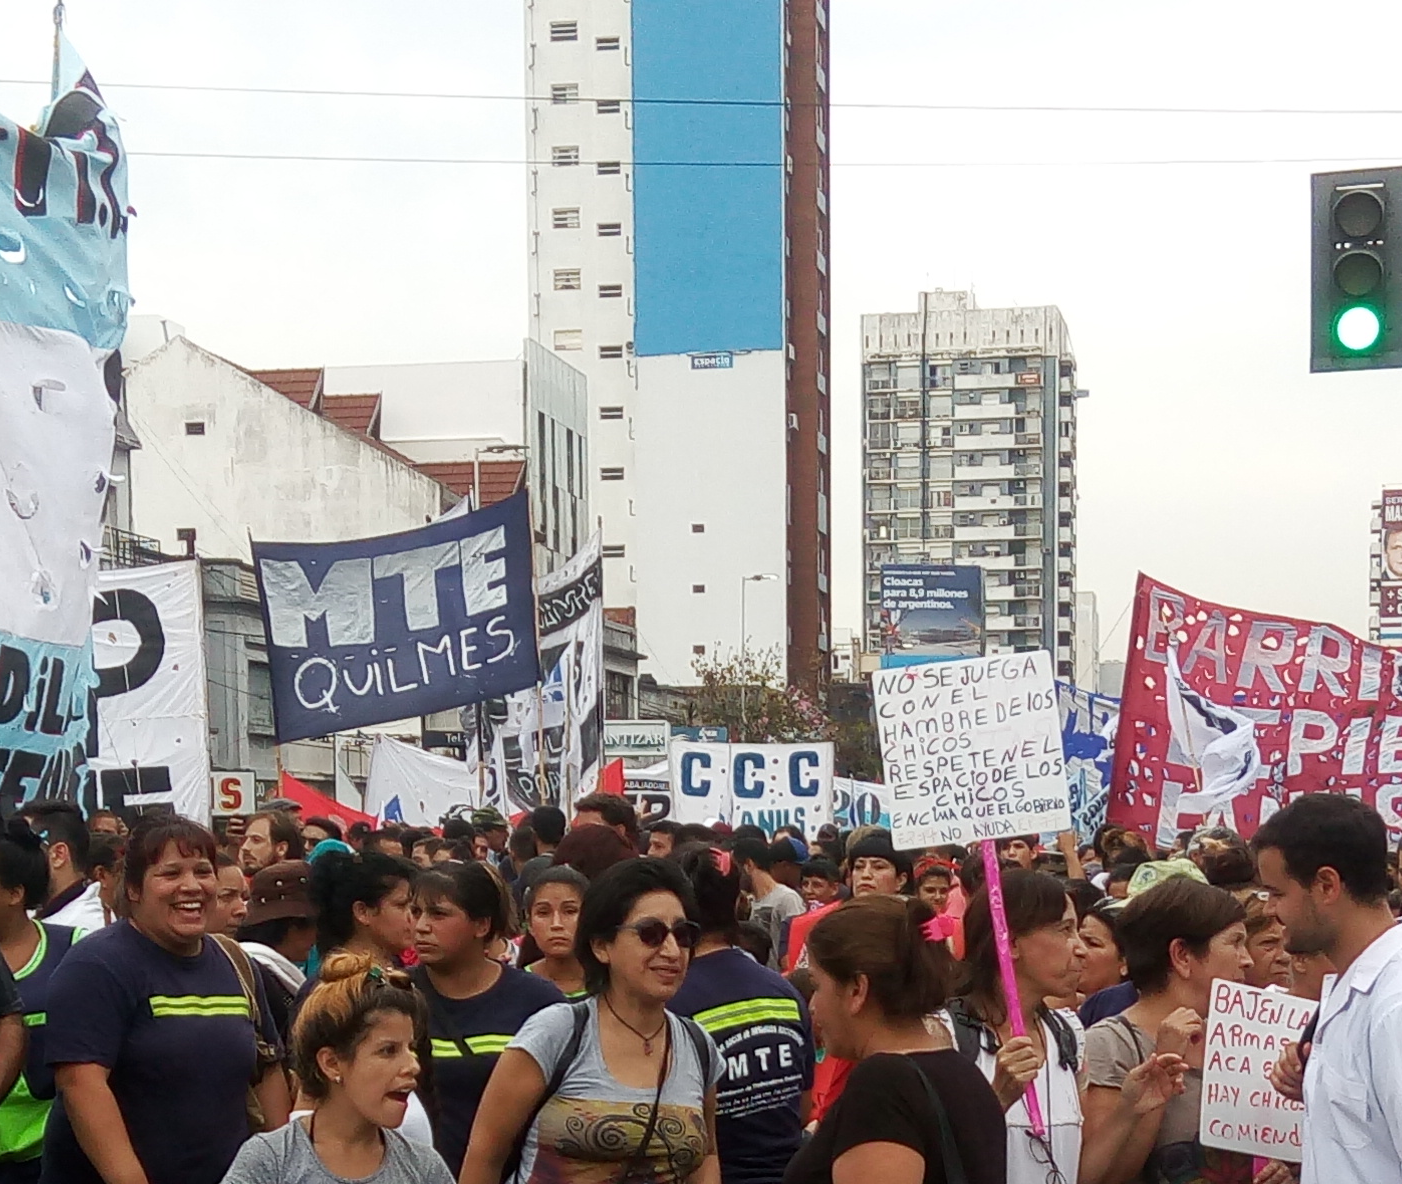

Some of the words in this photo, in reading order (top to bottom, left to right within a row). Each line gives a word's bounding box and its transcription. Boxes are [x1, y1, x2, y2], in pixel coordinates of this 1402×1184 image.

[258, 524, 507, 650] MTE
[883, 577, 924, 586] Cloacas
[883, 589, 907, 598] para
[909, 588, 925, 599] 8,9
[926, 588, 969, 598] millones
[883, 599, 896, 608] de
[898, 599, 955, 609] argentinos.
[877, 674, 915, 696] NO
[923, 666, 954, 690] SE
[960, 656, 1037, 687] JUEGA
[879, 693, 940, 719] CON
[951, 686, 988, 706] EL
[883, 708, 988, 744] HAMBRE
[997, 697, 1022, 723] DE
[889, 744, 1018, 784] RESPETEN
[991, 765, 1017, 783] DE
[1025, 757, 1063, 779] LOS
[960, 802, 995, 819] QUE
[998, 801, 1013, 815] EL
[940, 824, 962, 843] NO
[973, 818, 1016, 839] AYUDA
[1214, 983, 1284, 1024] BAJEN
[727, 1043, 793, 1081] MTE
[1207, 1083, 1240, 1108] HAY
